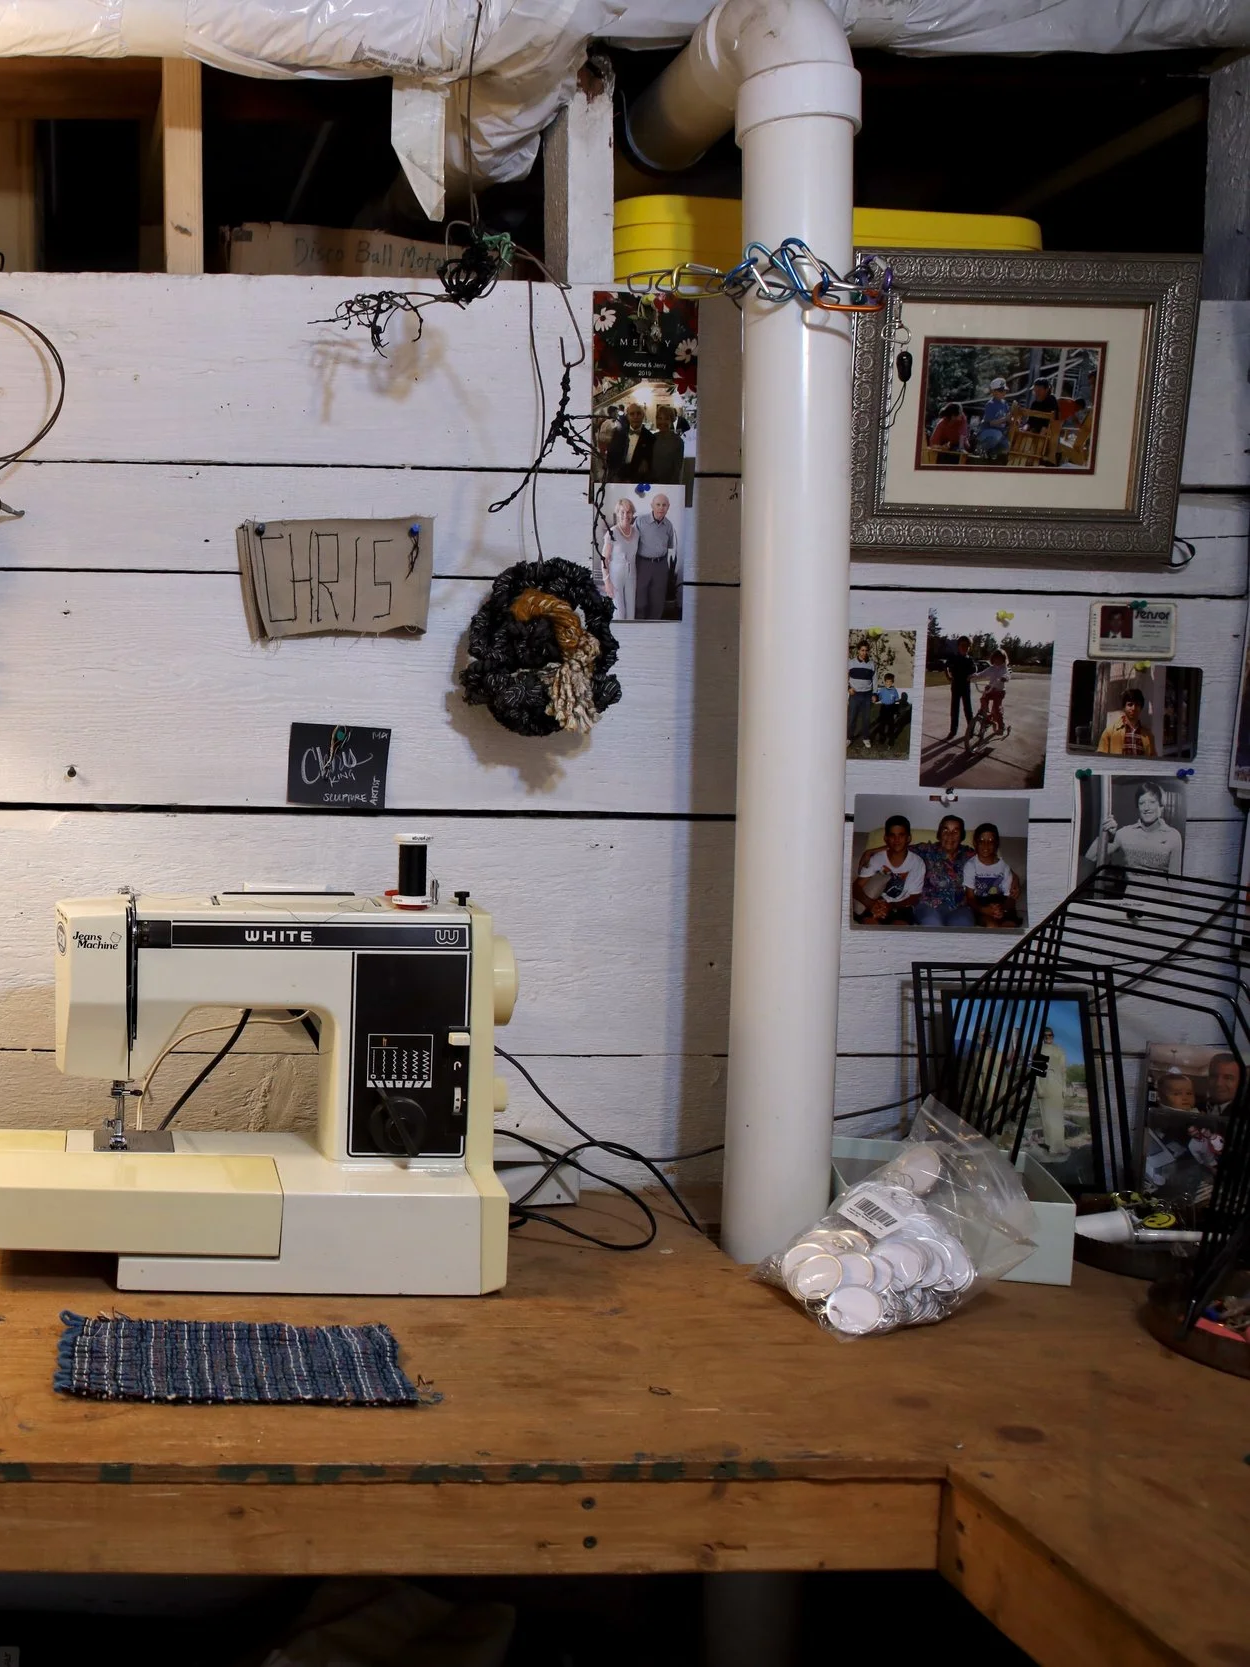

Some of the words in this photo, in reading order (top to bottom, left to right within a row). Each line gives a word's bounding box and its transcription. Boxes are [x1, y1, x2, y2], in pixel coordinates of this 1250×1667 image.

[295, 237, 344, 267] Disco
[355, 240, 392, 267] Ball
[259, 529, 394, 624] CHRIS
[370, 775, 381, 806] ARTIST
[72, 931, 102, 941] Jeans
[77, 940, 119, 950] Machine
[245, 930, 313, 942] WHITE
